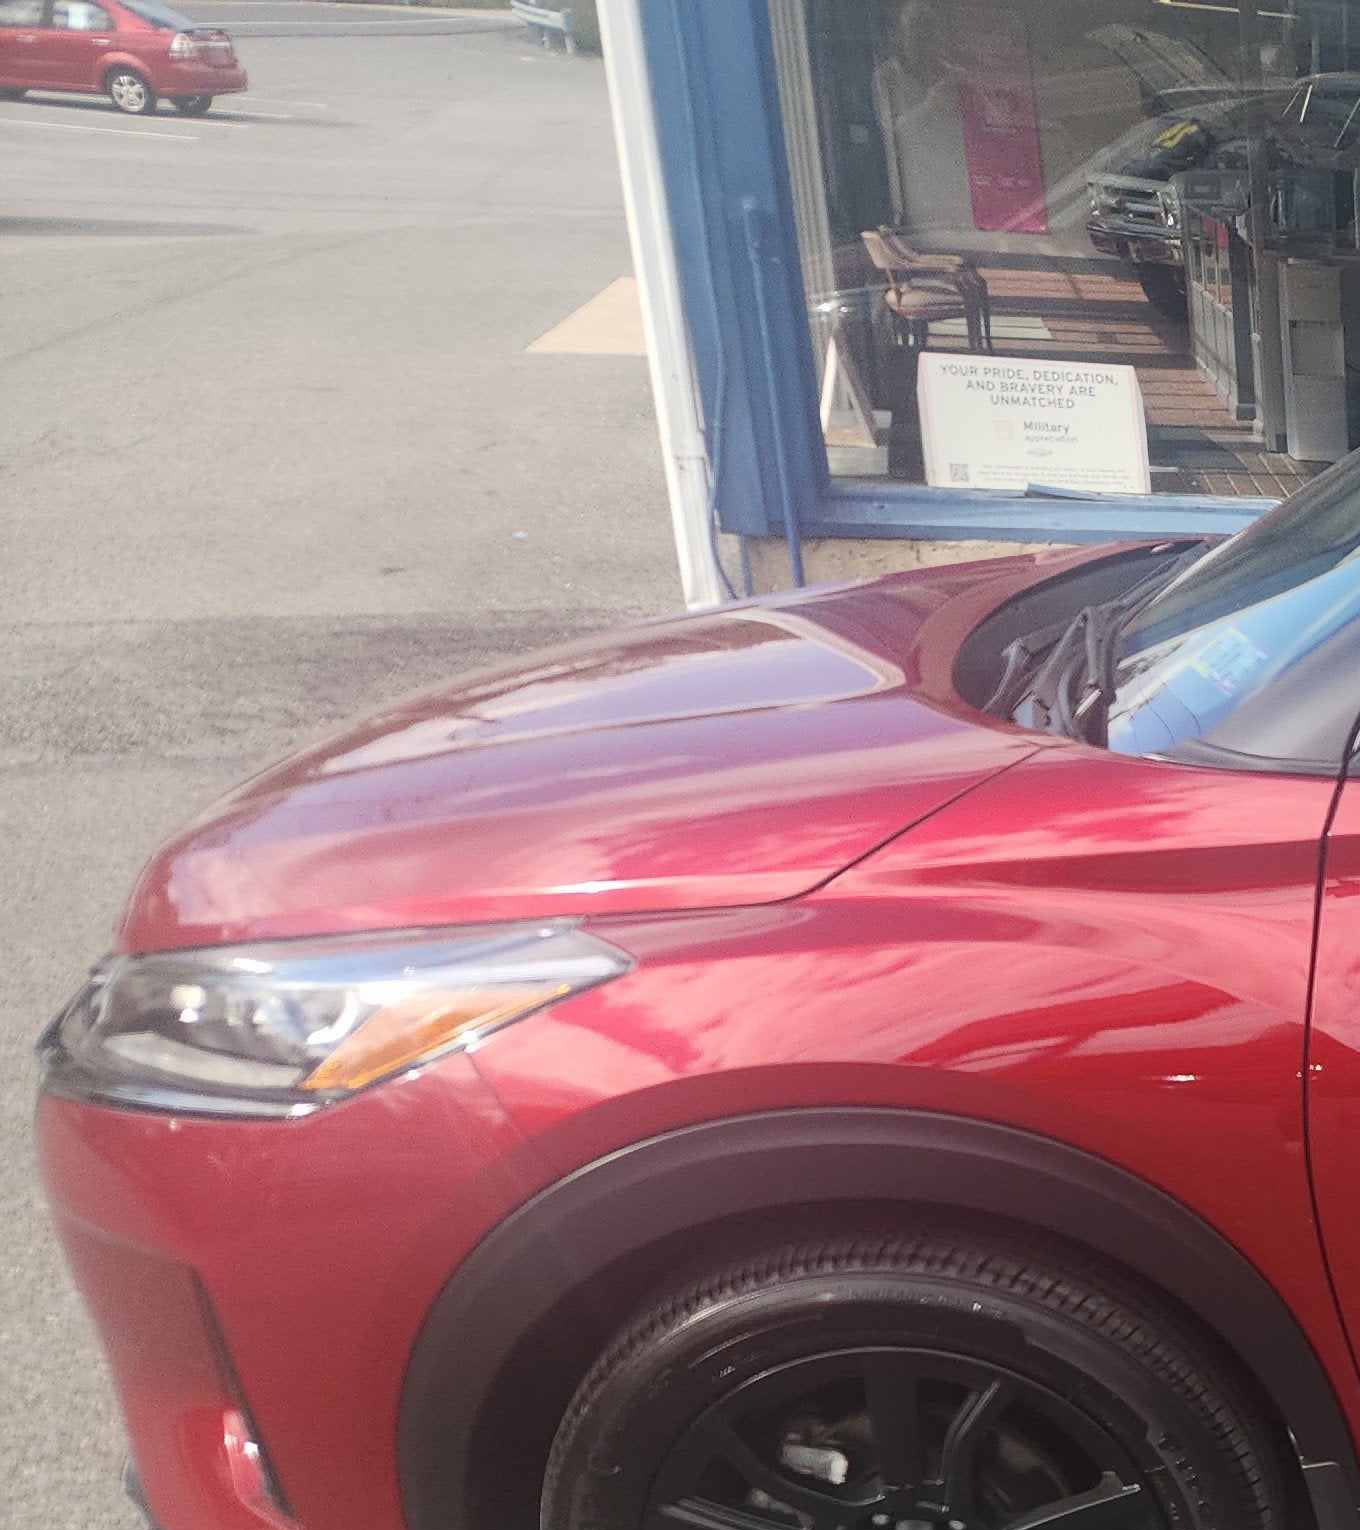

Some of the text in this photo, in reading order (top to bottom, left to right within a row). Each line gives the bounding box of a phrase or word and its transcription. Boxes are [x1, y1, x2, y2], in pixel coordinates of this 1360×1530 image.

[941, 363, 1118, 386] YOUR PRIDE, DEDICATION,
[966, 380, 1096, 397] AND BRAVERY ARE
[990, 394, 1075, 409] UNMATCHED
[1023, 421, 1070, 434] Military
